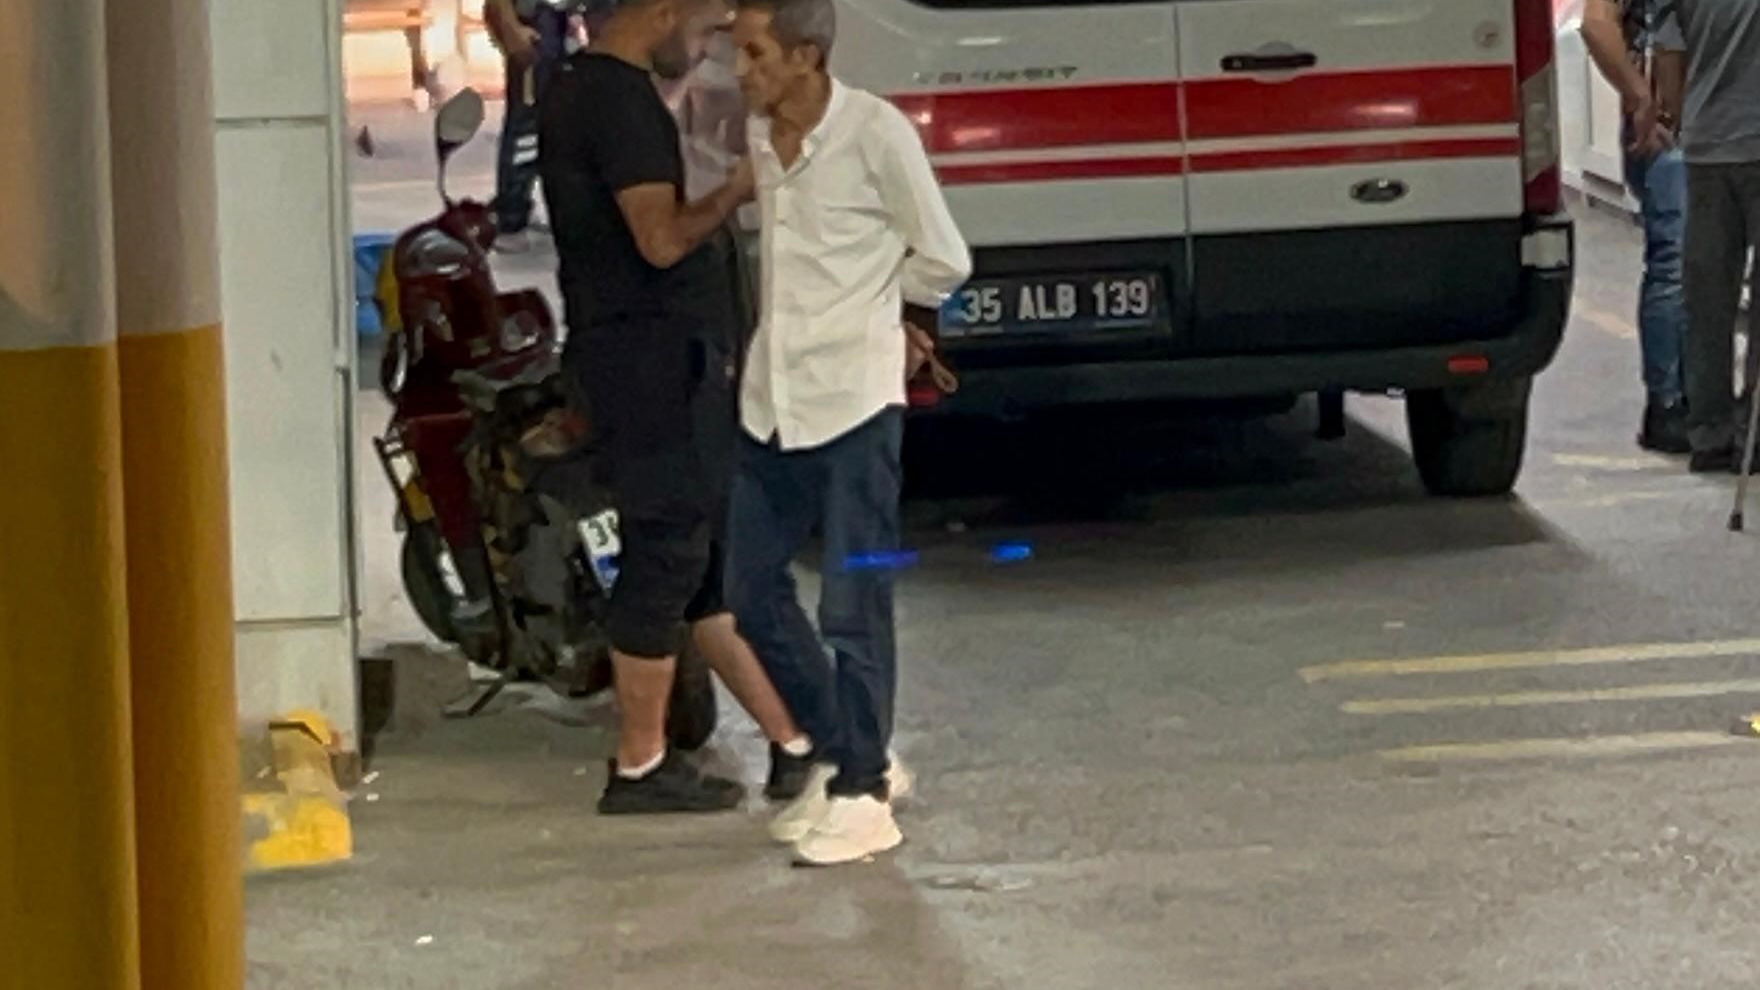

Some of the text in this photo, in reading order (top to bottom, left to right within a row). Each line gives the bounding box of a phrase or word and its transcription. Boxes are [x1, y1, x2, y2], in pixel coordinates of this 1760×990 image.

[961, 279, 1149, 323] 35 ALB 139
